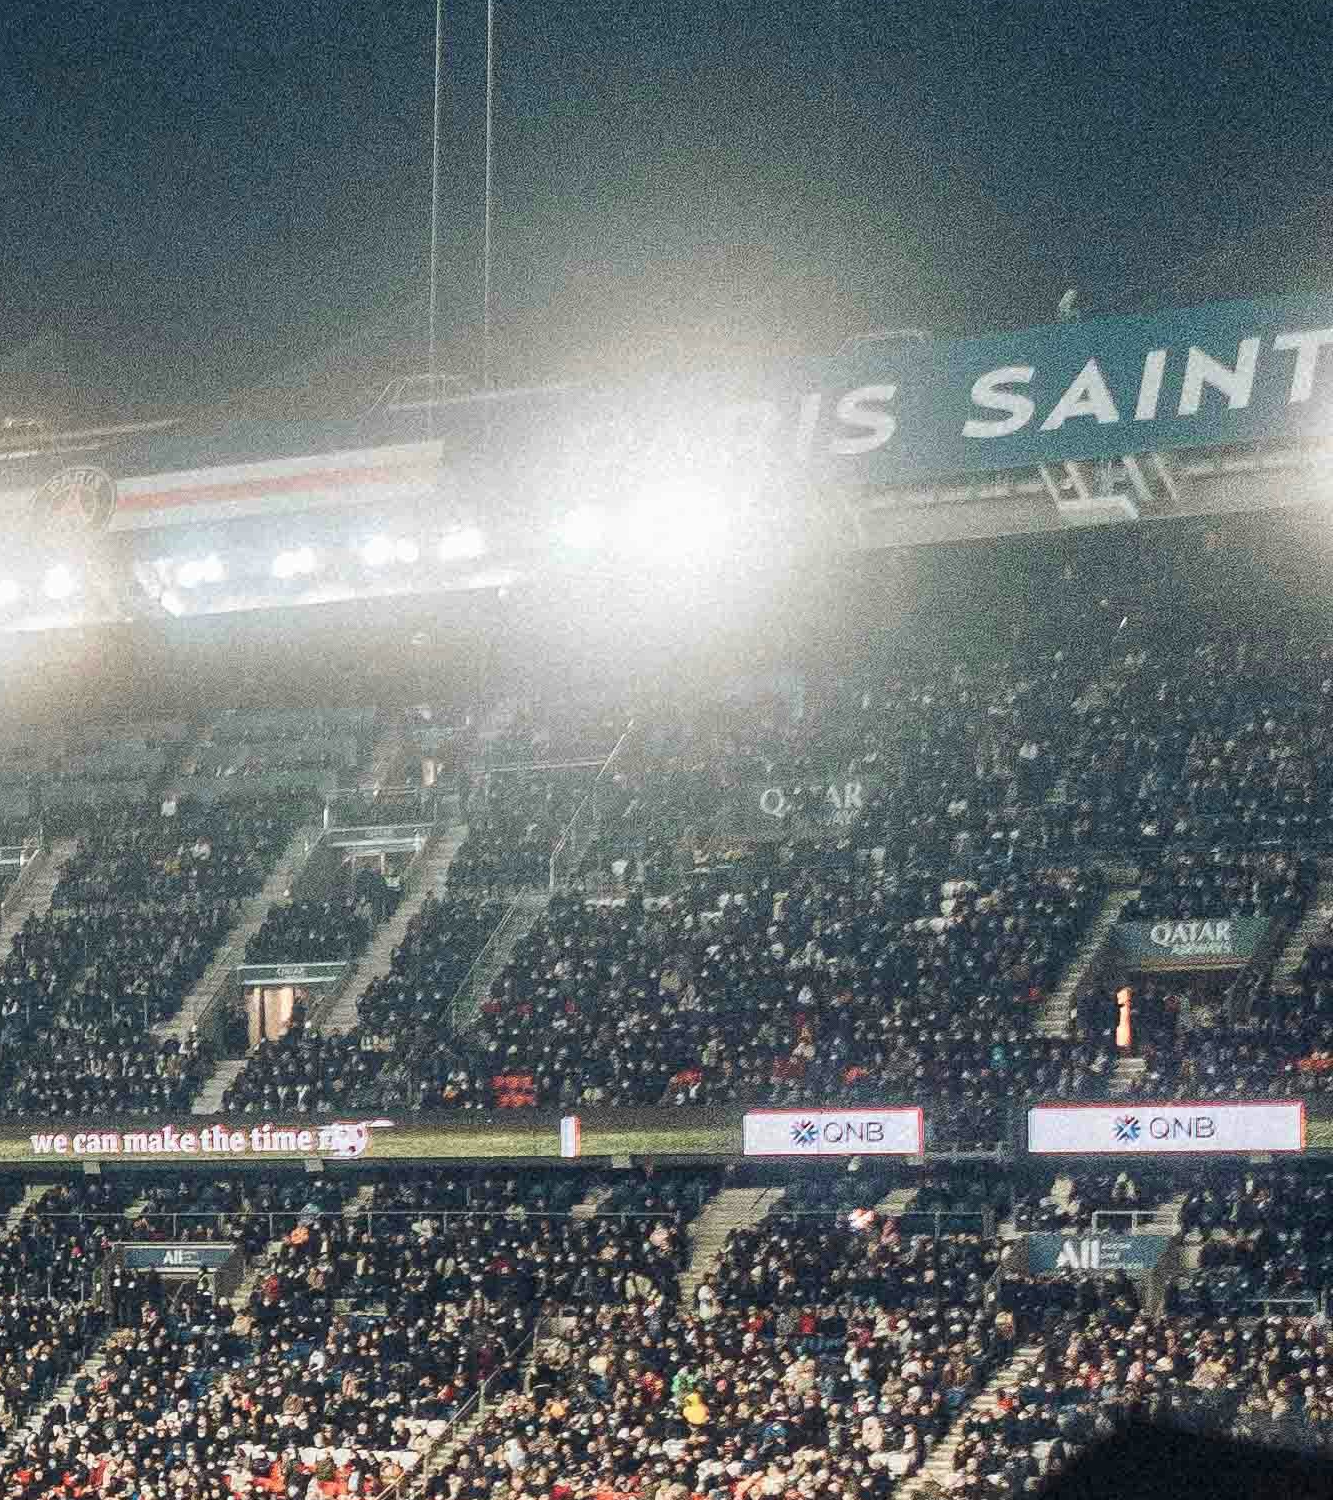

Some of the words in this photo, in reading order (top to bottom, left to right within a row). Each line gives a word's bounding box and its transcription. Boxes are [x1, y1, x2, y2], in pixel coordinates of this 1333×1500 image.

[30, 1132, 68, 1155] we
[72, 1132, 119, 1155] can
[123, 1125, 197, 1154] make
[199, 1123, 244, 1153] the
[250, 1122, 313, 1152] time
[823, 1119, 885, 1143] QNB
[1149, 1115, 1216, 1140] QNB
